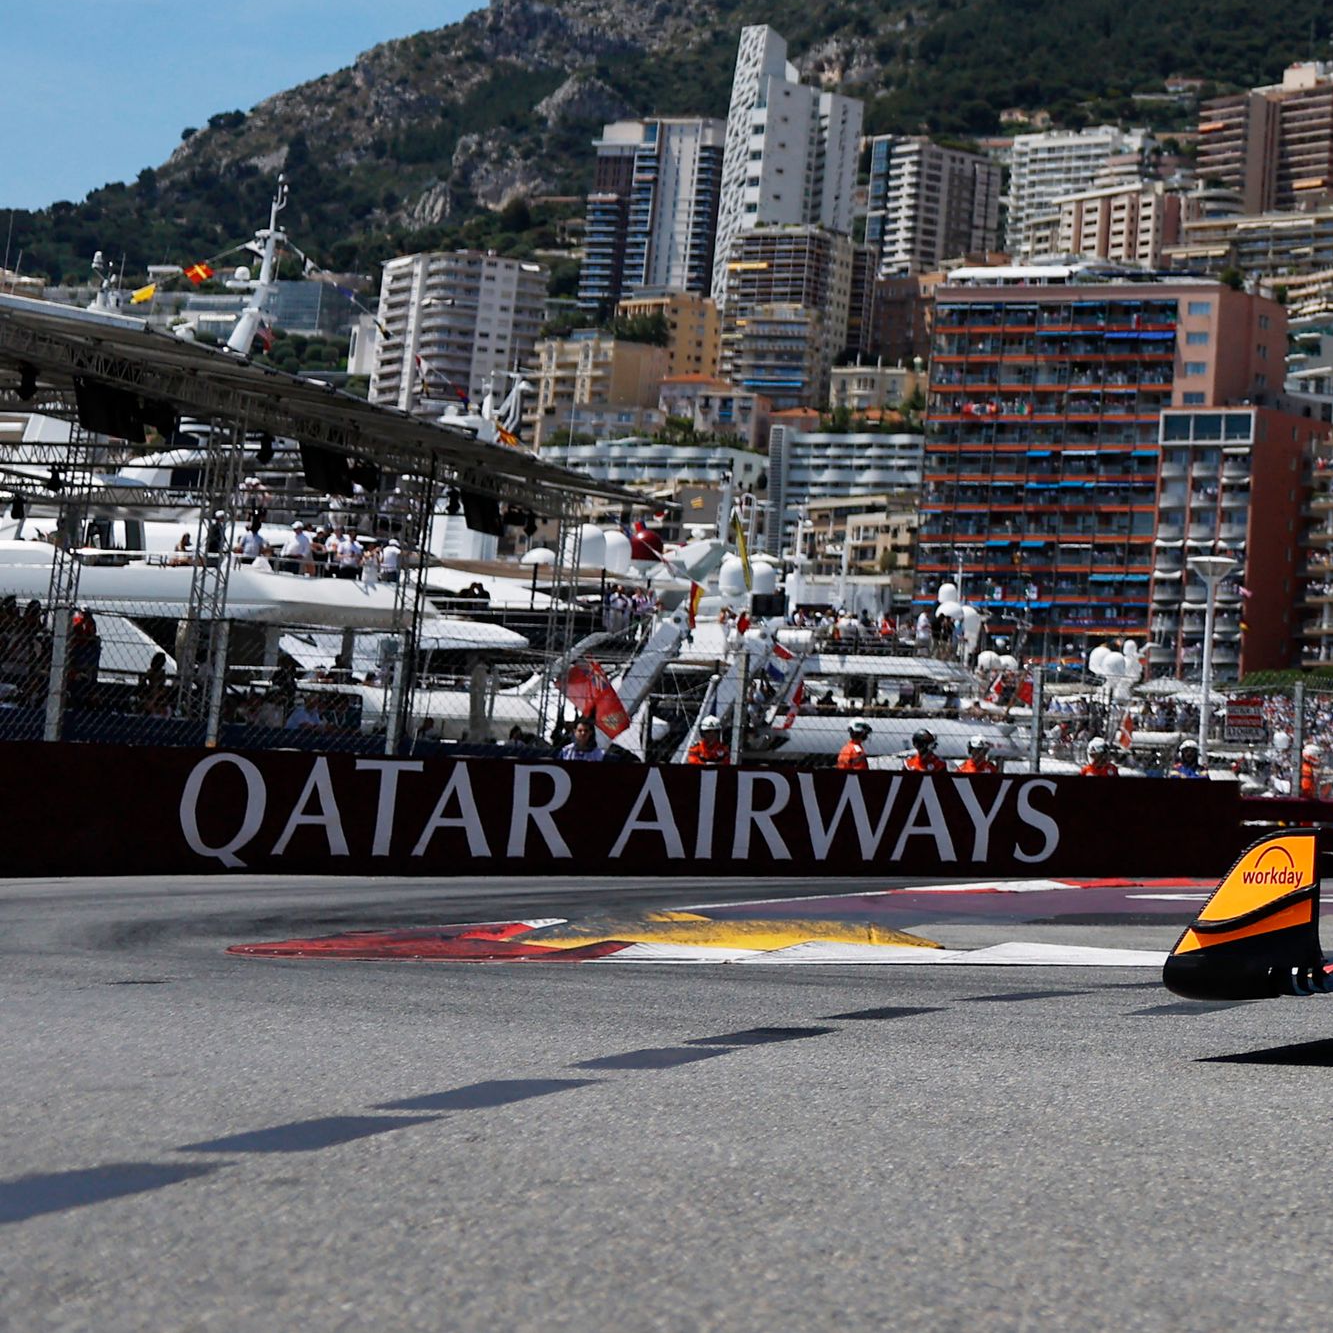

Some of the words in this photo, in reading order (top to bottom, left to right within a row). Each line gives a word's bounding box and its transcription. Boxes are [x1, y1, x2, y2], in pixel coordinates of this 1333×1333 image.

[180, 752, 573, 868] QATAR
[608, 767, 1060, 864] AIRWAYS
[1243, 866, 1303, 888] workday
